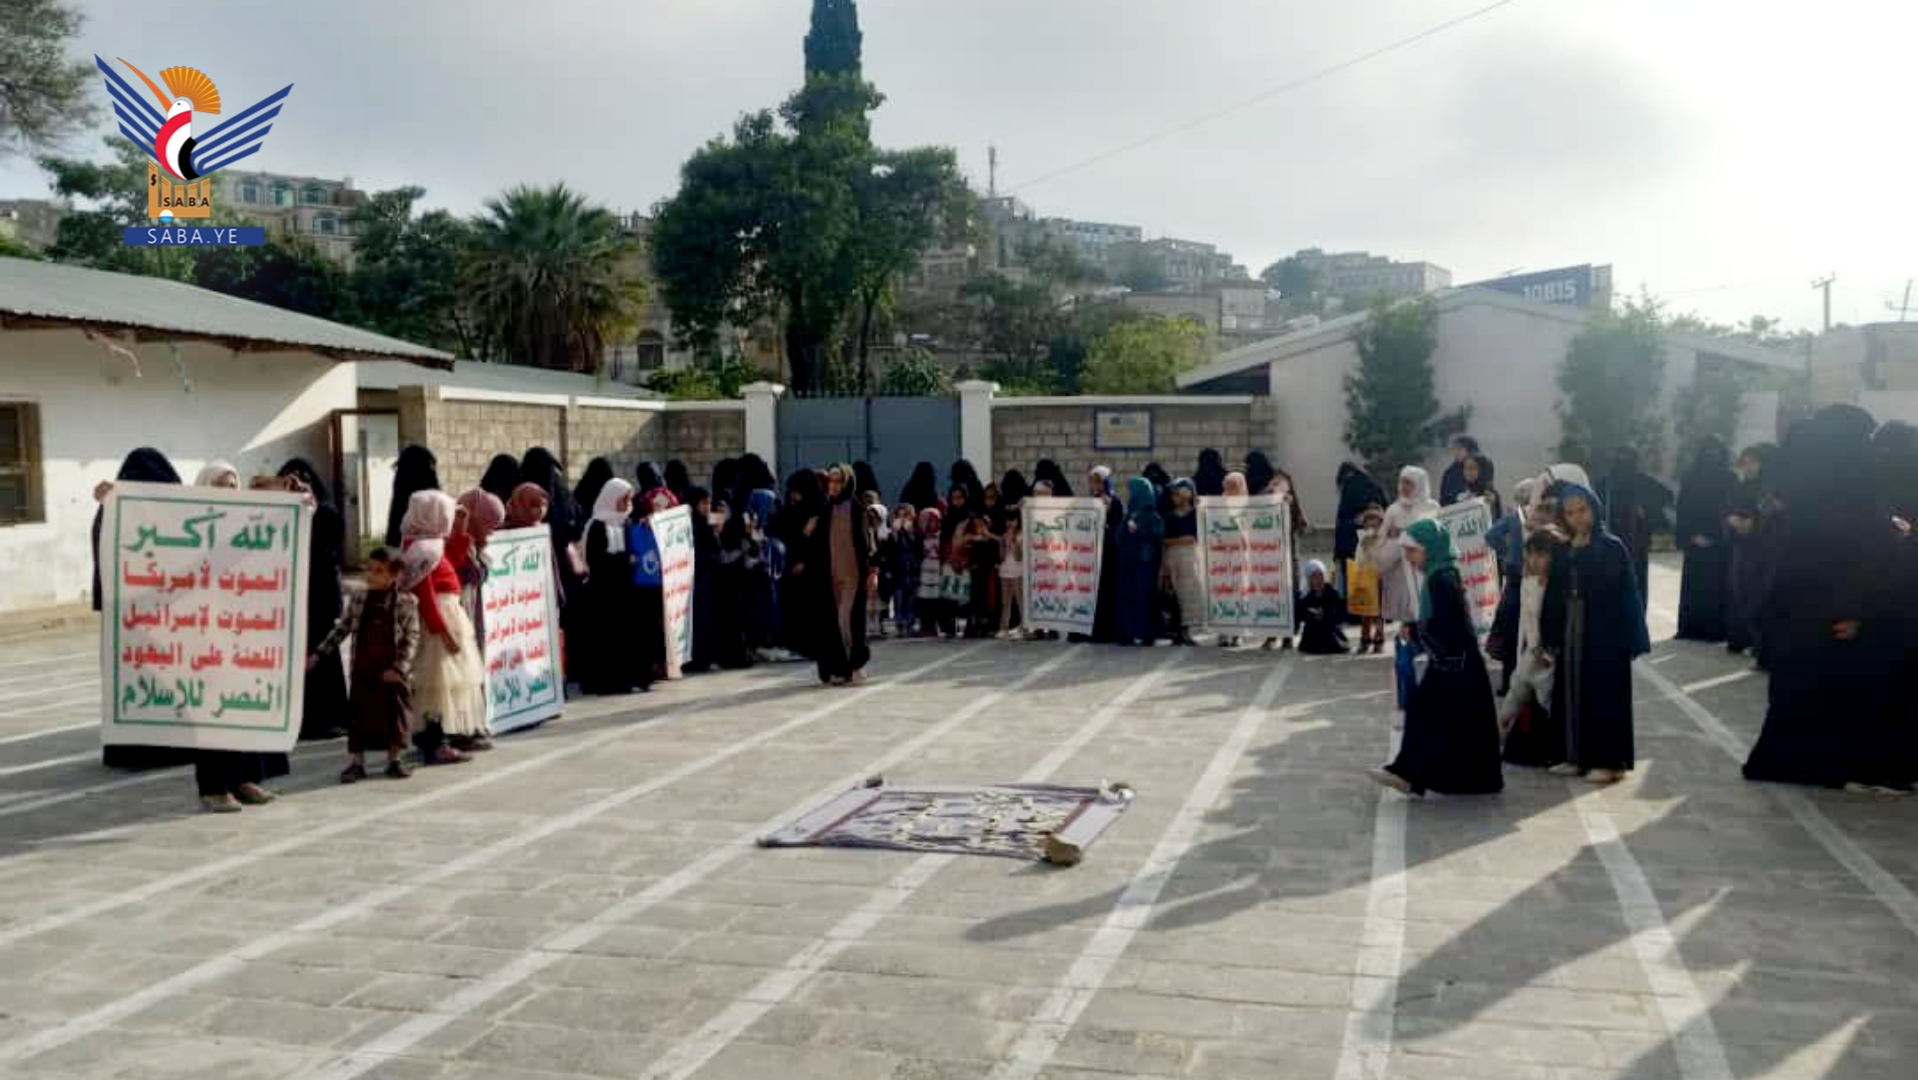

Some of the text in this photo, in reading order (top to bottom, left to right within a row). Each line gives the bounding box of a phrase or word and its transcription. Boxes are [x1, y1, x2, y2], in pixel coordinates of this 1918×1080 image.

[229, 512, 290, 551] الله
[217, 566, 288, 596] الموت
[216, 606, 286, 635] الموت
[211, 679, 283, 718] النصر
